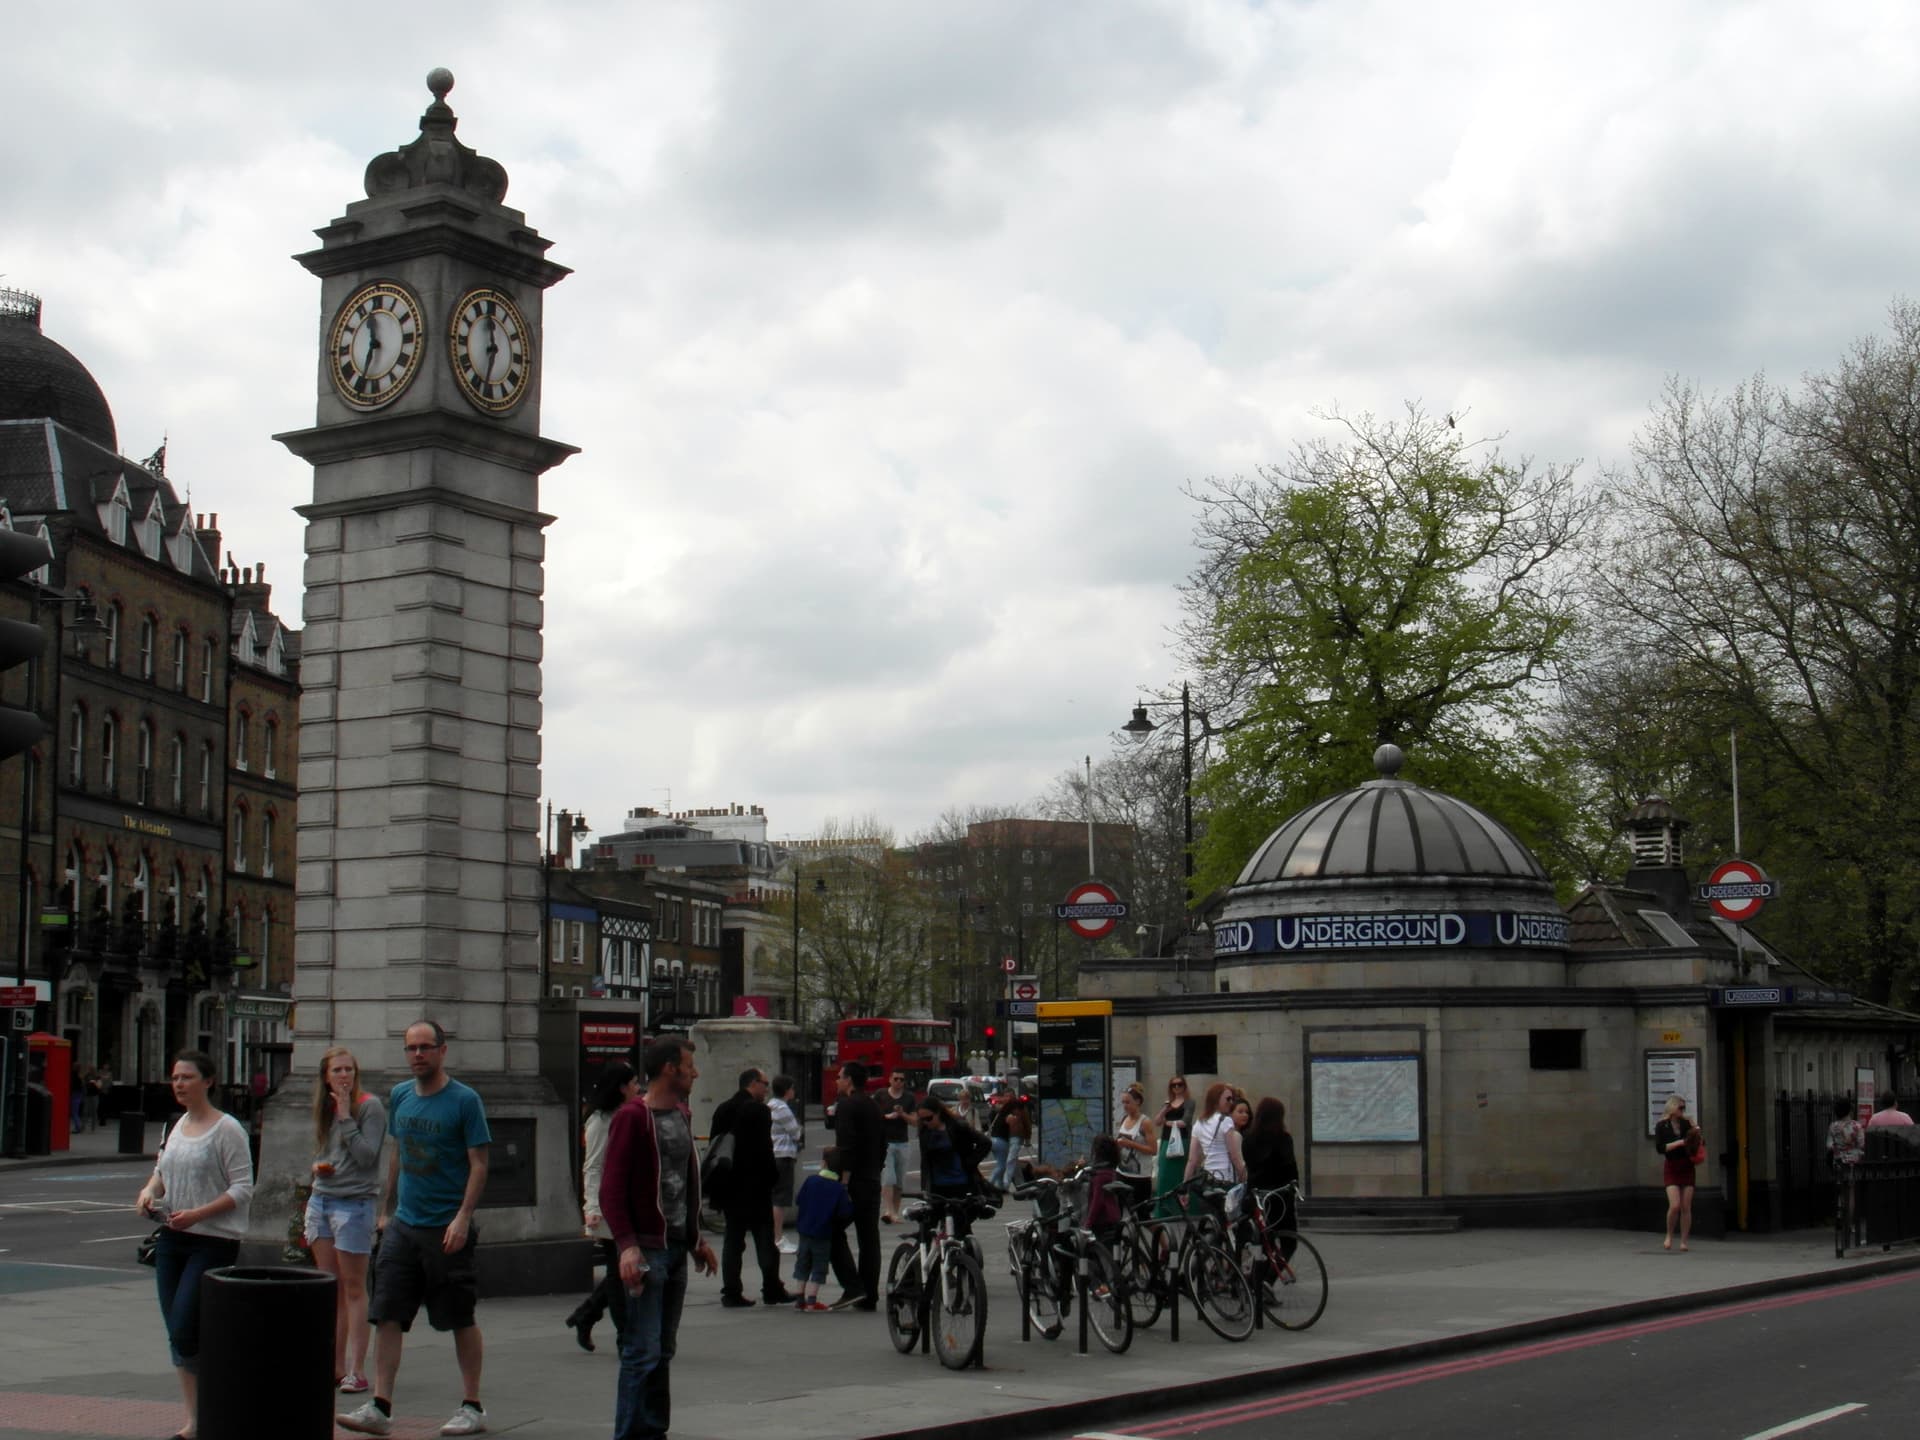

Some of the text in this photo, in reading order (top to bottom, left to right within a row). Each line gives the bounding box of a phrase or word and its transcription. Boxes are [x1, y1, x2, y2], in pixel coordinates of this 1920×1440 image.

[123, 815, 137, 829] The
[1701, 883, 1771, 899] UNDERGROUND
[1058, 904, 1126, 918] UNDERGROUND
[1276, 913, 1466, 950] UNDERGROUND
[1006, 959, 1016, 971] D
